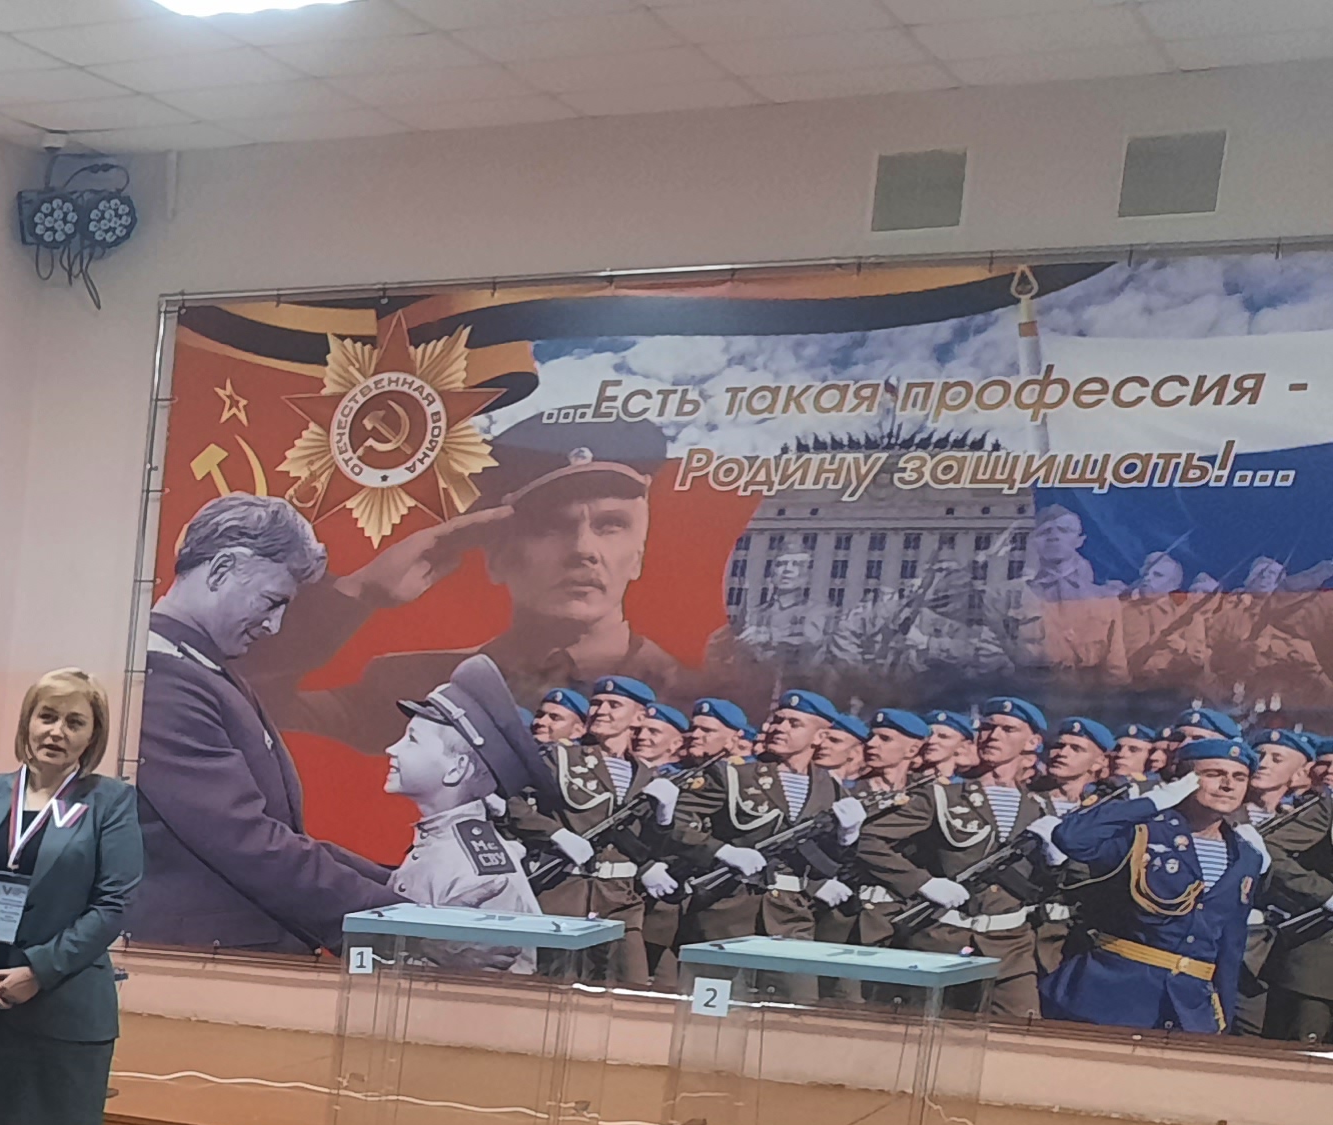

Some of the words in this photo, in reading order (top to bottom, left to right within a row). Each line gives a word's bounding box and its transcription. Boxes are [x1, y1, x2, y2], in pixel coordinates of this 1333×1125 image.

[724, 381, 881, 418] такая
[899, 364, 1267, 424] профессия
[336, 376, 436, 477] ОТЕЧЕСТВЕННАЯ
[674, 447, 888, 501] Родину
[355, 951, 368, 969] 1
[703, 987, 718, 1008] 2
